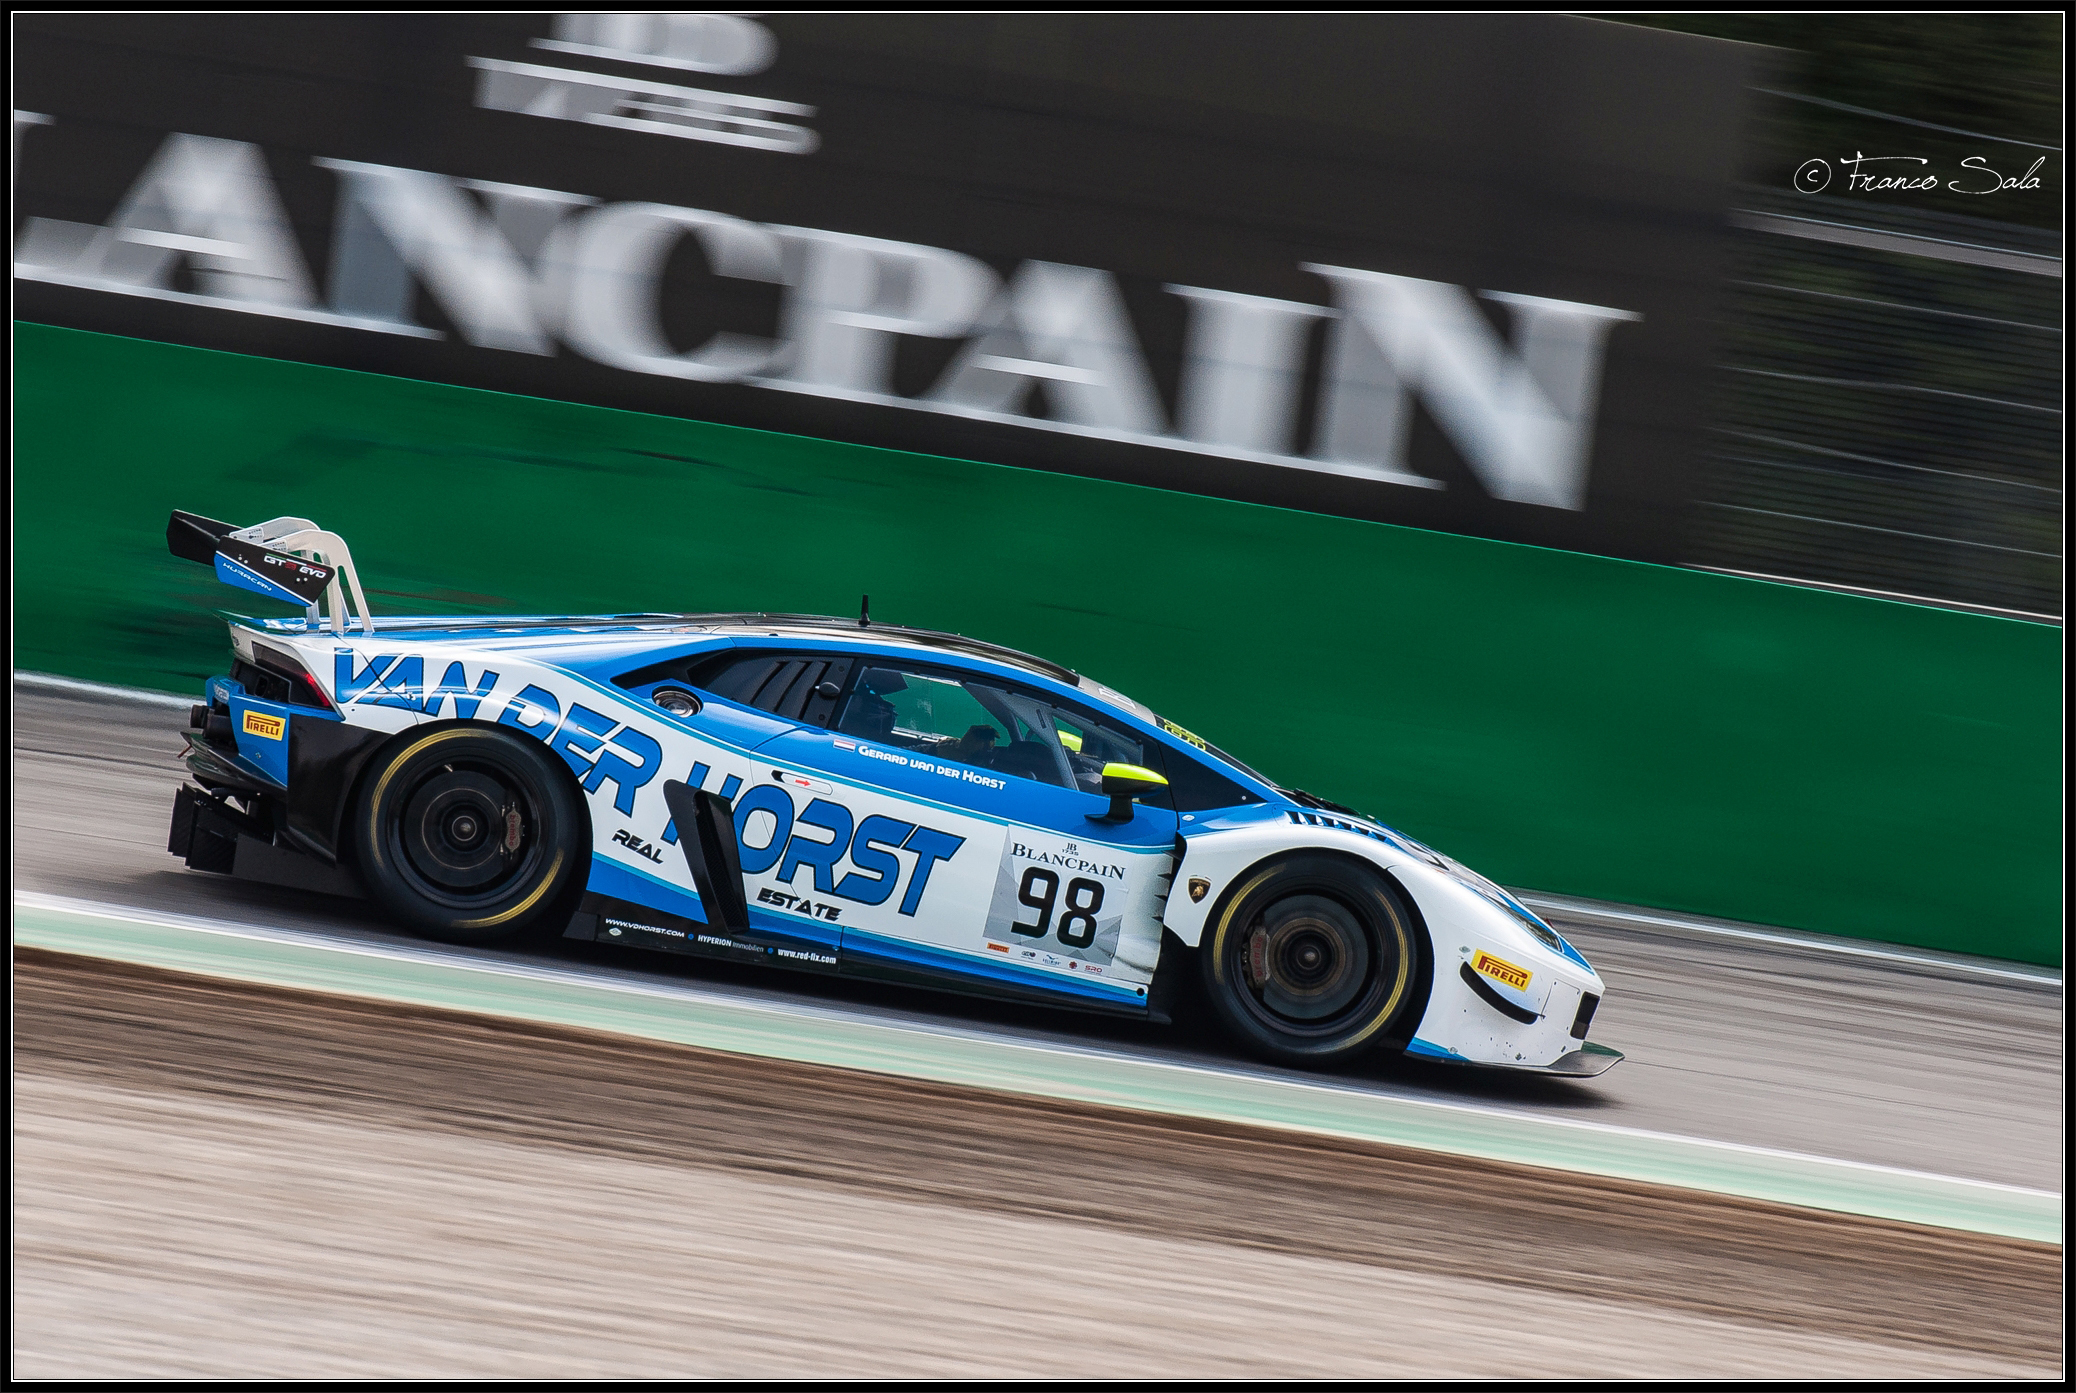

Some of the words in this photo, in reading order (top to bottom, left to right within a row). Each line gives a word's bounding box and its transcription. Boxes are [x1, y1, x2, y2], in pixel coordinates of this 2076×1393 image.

[264, 555, 297, 571] GT3
[299, 565, 327, 579] EVO
[245, 714, 281, 736] PIRELLI
[333, 647, 501, 720] VAN
[497, 683, 664, 819] DER
[611, 828, 664, 865] REAL
[1010, 841, 1127, 881] BLANCPAIN
[756, 886, 843, 922] ESTATE
[1010, 866, 1106, 950] 98
[697, 933, 732, 948] HYPERION
[1477, 955, 1529, 988] PIRELLI
